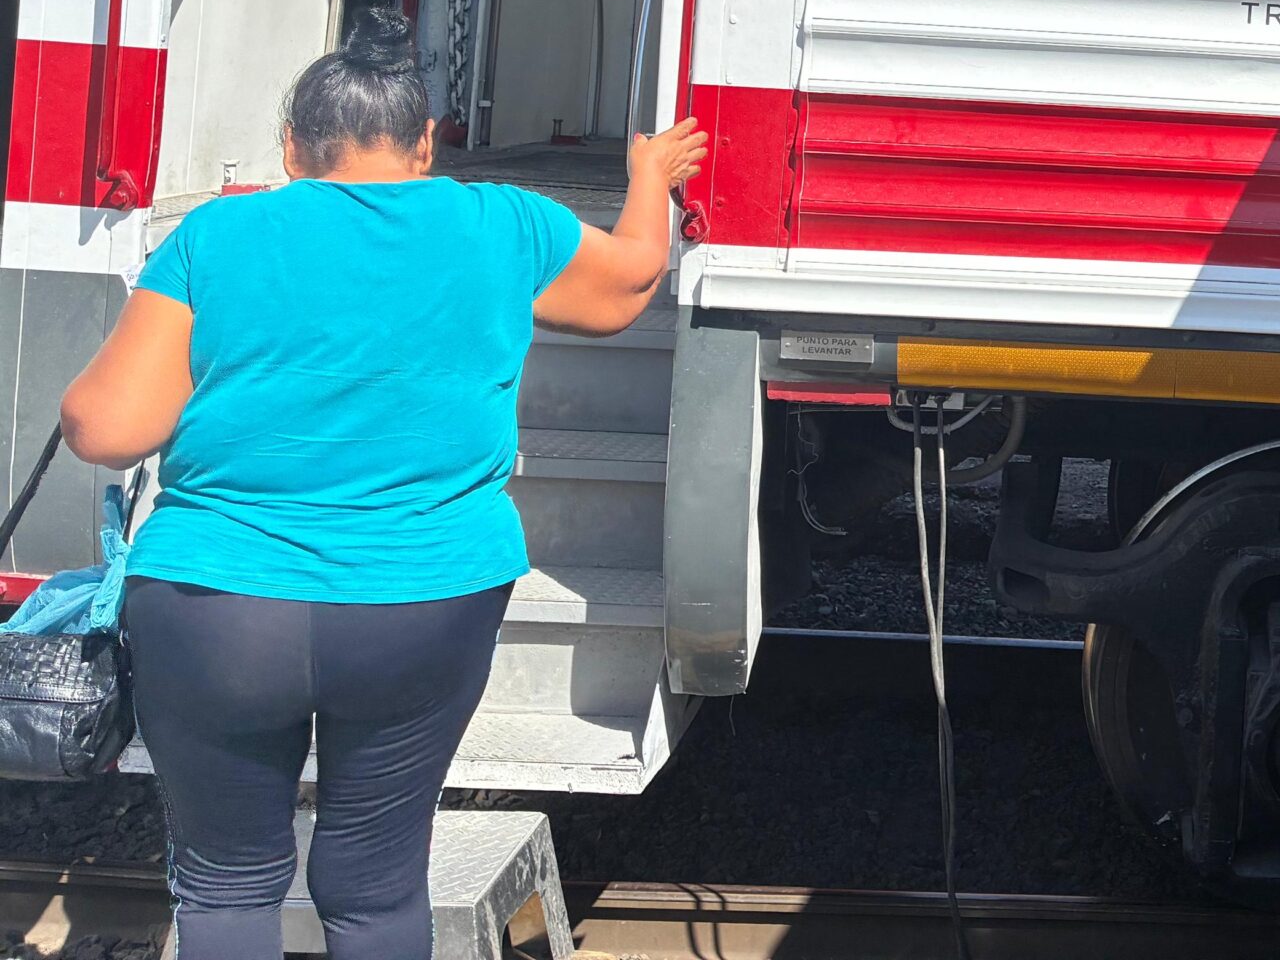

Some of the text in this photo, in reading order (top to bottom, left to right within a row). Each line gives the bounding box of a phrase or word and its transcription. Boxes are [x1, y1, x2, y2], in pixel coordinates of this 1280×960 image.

[796, 336, 857, 346] PUNTO PARA
[802, 346, 852, 356] LEVANTAR
